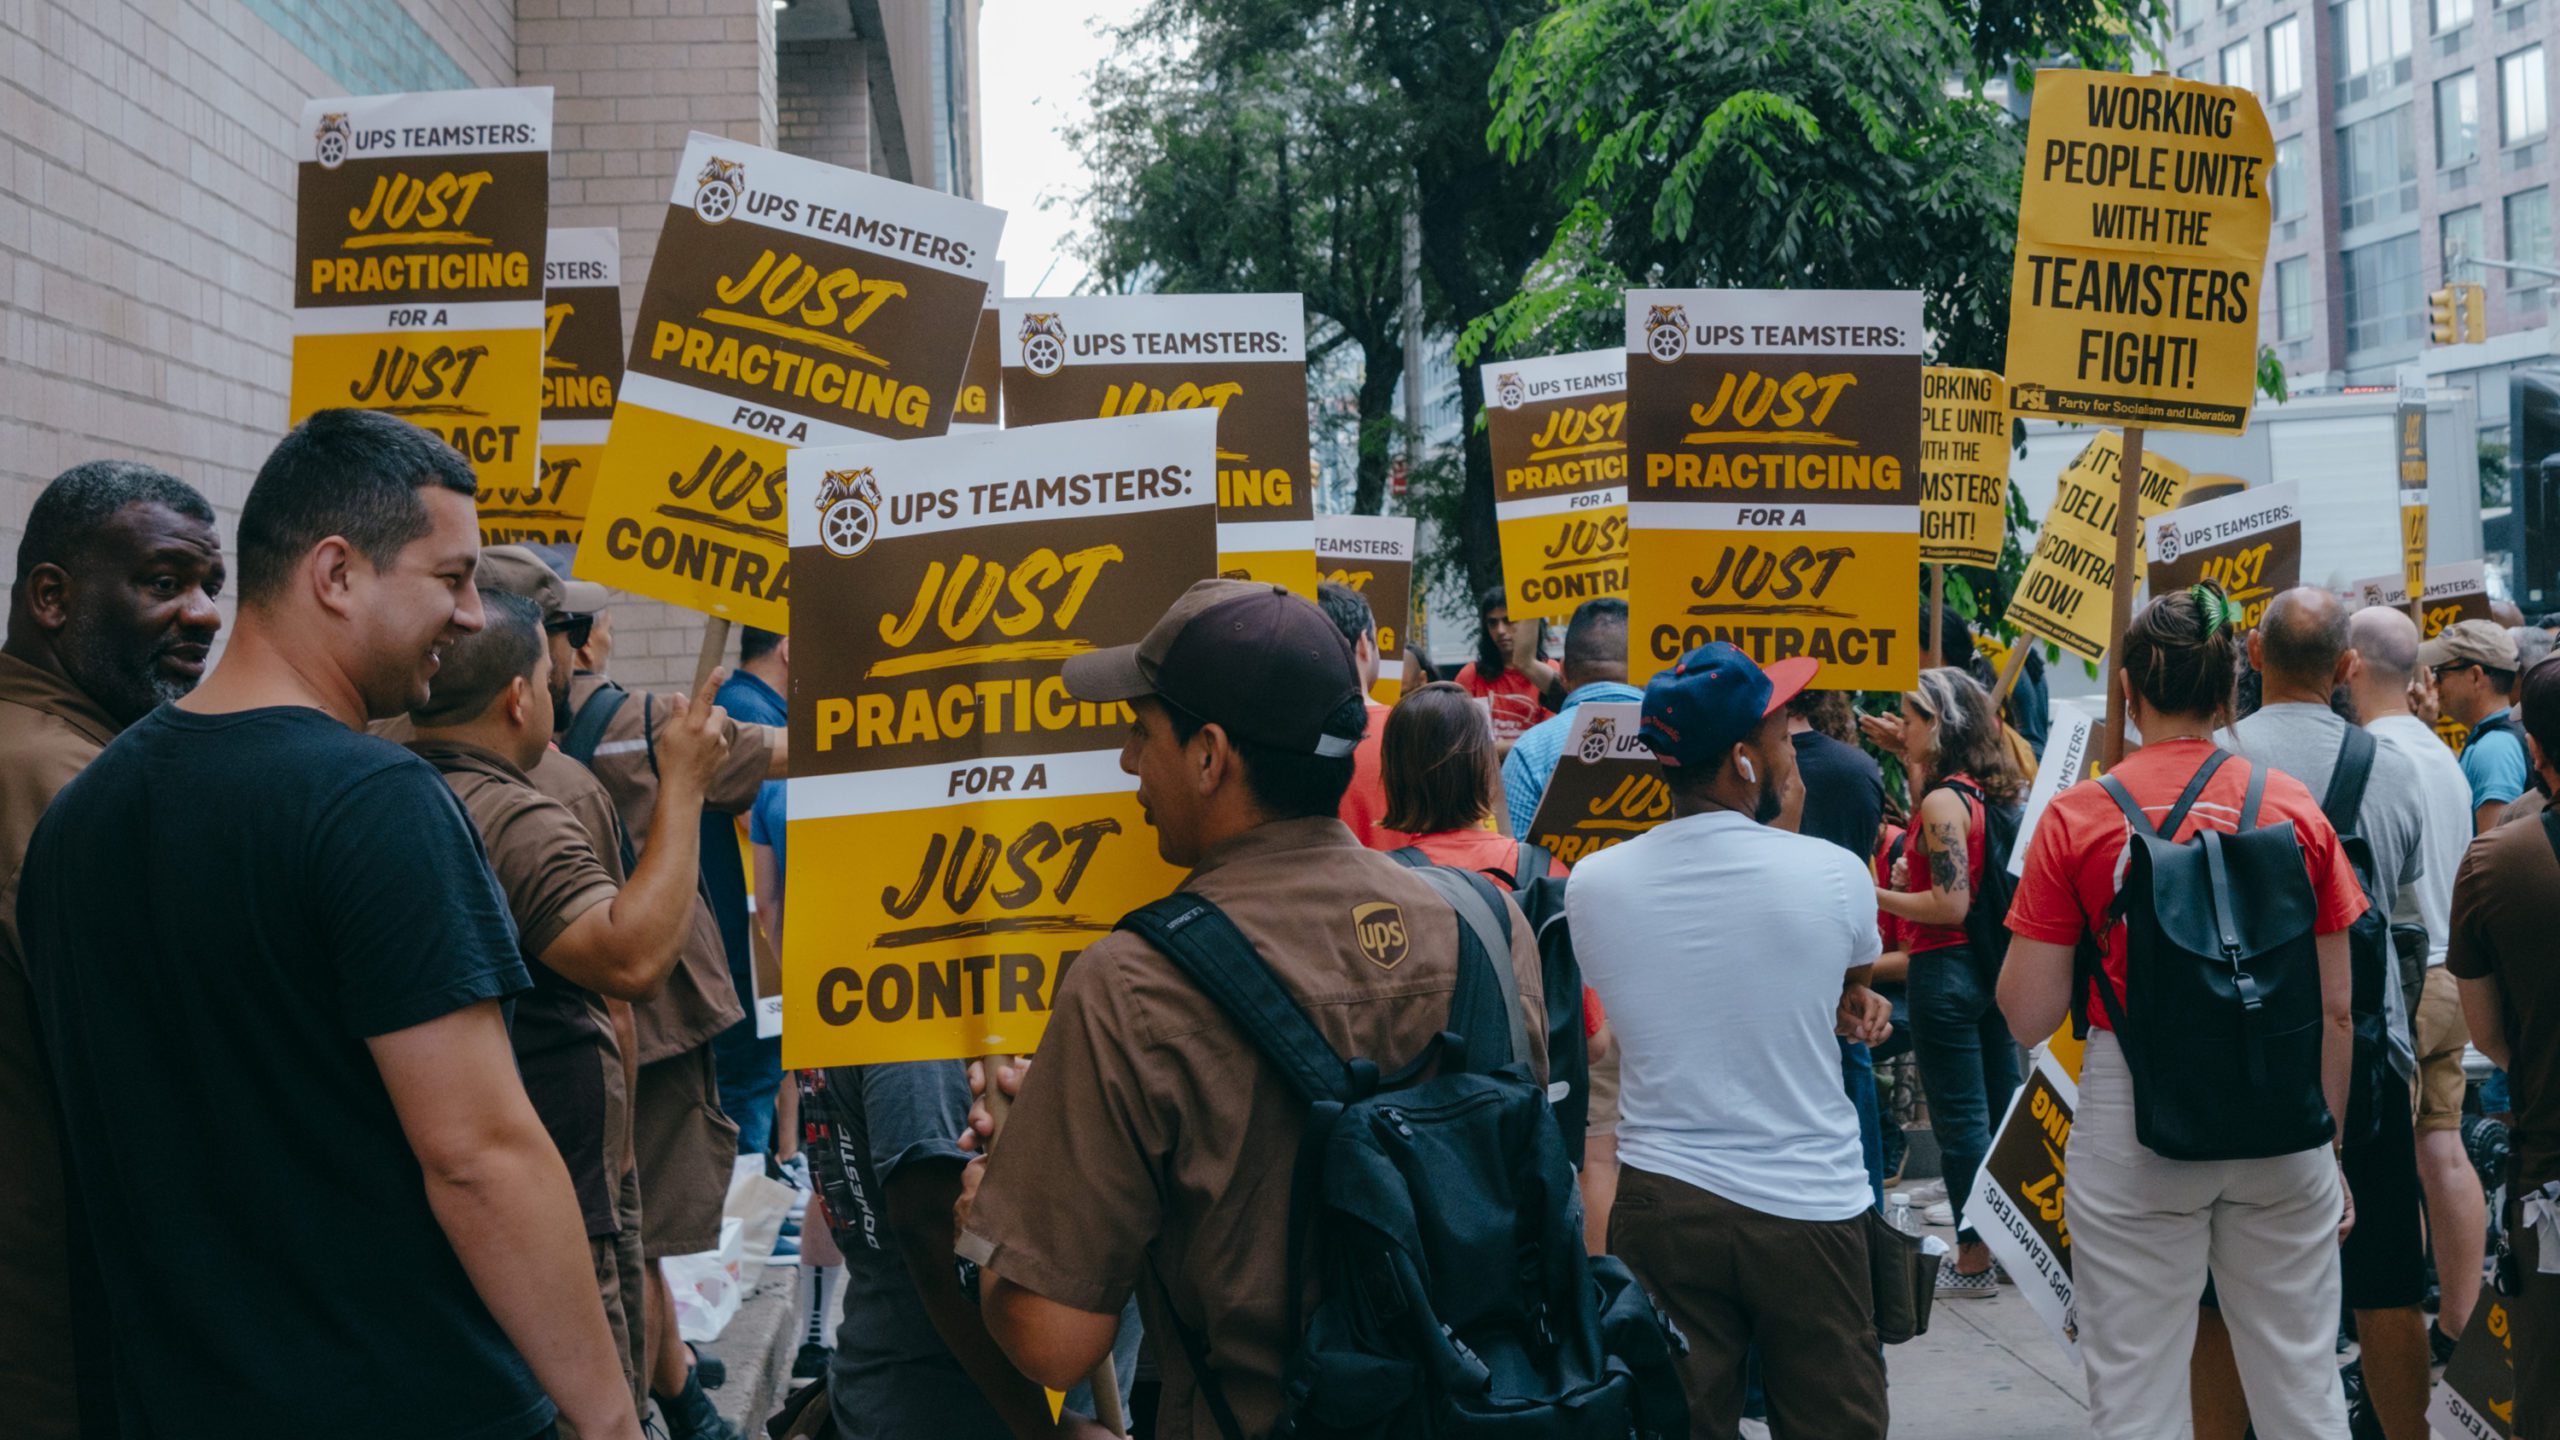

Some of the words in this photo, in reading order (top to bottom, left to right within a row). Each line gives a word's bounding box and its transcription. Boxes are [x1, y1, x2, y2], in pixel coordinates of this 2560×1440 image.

[2088, 84, 2236, 139] WORKING
[355, 128, 397, 151] UPS
[402, 124, 535, 148] TEAMSTERS:
[2044, 139, 2169, 190] PEOPLE
[2174, 149, 2263, 199] UNITE
[349, 171, 493, 230] JUST
[747, 190, 797, 222] UPS
[806, 204, 976, 268] TEAMSTERS:
[2092, 202, 2160, 242] WITH
[2165, 208, 2211, 247] THE
[312, 252, 529, 293] PRACTICING
[545, 261, 607, 279] STERS:
[2028, 255, 2250, 324] TEAMSTERS
[716, 249, 906, 333] JUST
[388, 309, 427, 327] FOR
[432, 309, 448, 326] A
[1695, 325, 1744, 347] UPS
[1751, 325, 1905, 347] TEAMSTERS:
[1073, 334, 1126, 356] UPS
[1132, 331, 1288, 355] TEAMSTERS:
[2077, 329, 2198, 390] FIGHT!
[351, 346, 488, 401] JUST
[651, 320, 930, 428] PRACTICING
[1529, 380, 1560, 397] UPS
[1564, 371, 1627, 392] TEAMST
[1924, 374, 1992, 402] ORKING
[1690, 371, 1858, 428] JUST
[2016, 390, 2050, 411] PSL
[2058, 396, 2090, 412] Party
[2093, 399, 2110, 411] for
[2113, 401, 2164, 416] Socialism
[2166, 406, 2186, 418] and
[2187, 407, 2235, 423] Liberation
[731, 406, 781, 435] FOR
[787, 422, 807, 441] A
[1531, 401, 1627, 448] JUST
[1957, 409, 2004, 436] UNITE
[1647, 453, 1901, 490] PRACTICING
[1921, 440, 1948, 460] ITH
[1952, 441, 1980, 462] THE
[668, 445, 787, 521] JUS
[1506, 454, 1628, 493] PRACTICI
[1921, 472, 2001, 506] MSTERS
[891, 488, 959, 525] UPS
[969, 465, 1192, 516] TEAMSTERS:
[1570, 494, 1599, 508] FOR
[1603, 493, 1613, 505] A
[1737, 509, 1785, 527] FOR
[1789, 509, 1807, 527] A
[1920, 510, 1975, 541] IGHT!
[2184, 527, 2212, 547] UPS
[2214, 505, 2293, 538] TEAMSTERS:
[605, 518, 789, 606] CONTRA
[1691, 545, 1855, 600] JUST
[879, 543, 1124, 649] JUST
[1521, 566, 1628, 603] CONTR
[2023, 569, 2083, 620] NOW!
[2385, 591, 2405, 602] UPS
[2424, 579, 2479, 596] AMSTERS:
[948, 765, 1014, 798] FOR
[1020, 763, 1048, 792] A
[1589, 774, 1670, 818] JUS
[881, 817, 1122, 920] JUST
[1360, 921, 1404, 959] ups
[817, 950, 1082, 1027] CONTR
[1984, 1181, 2056, 1279] TEAMSTERS:
[2049, 1270, 2073, 1308] UPS
